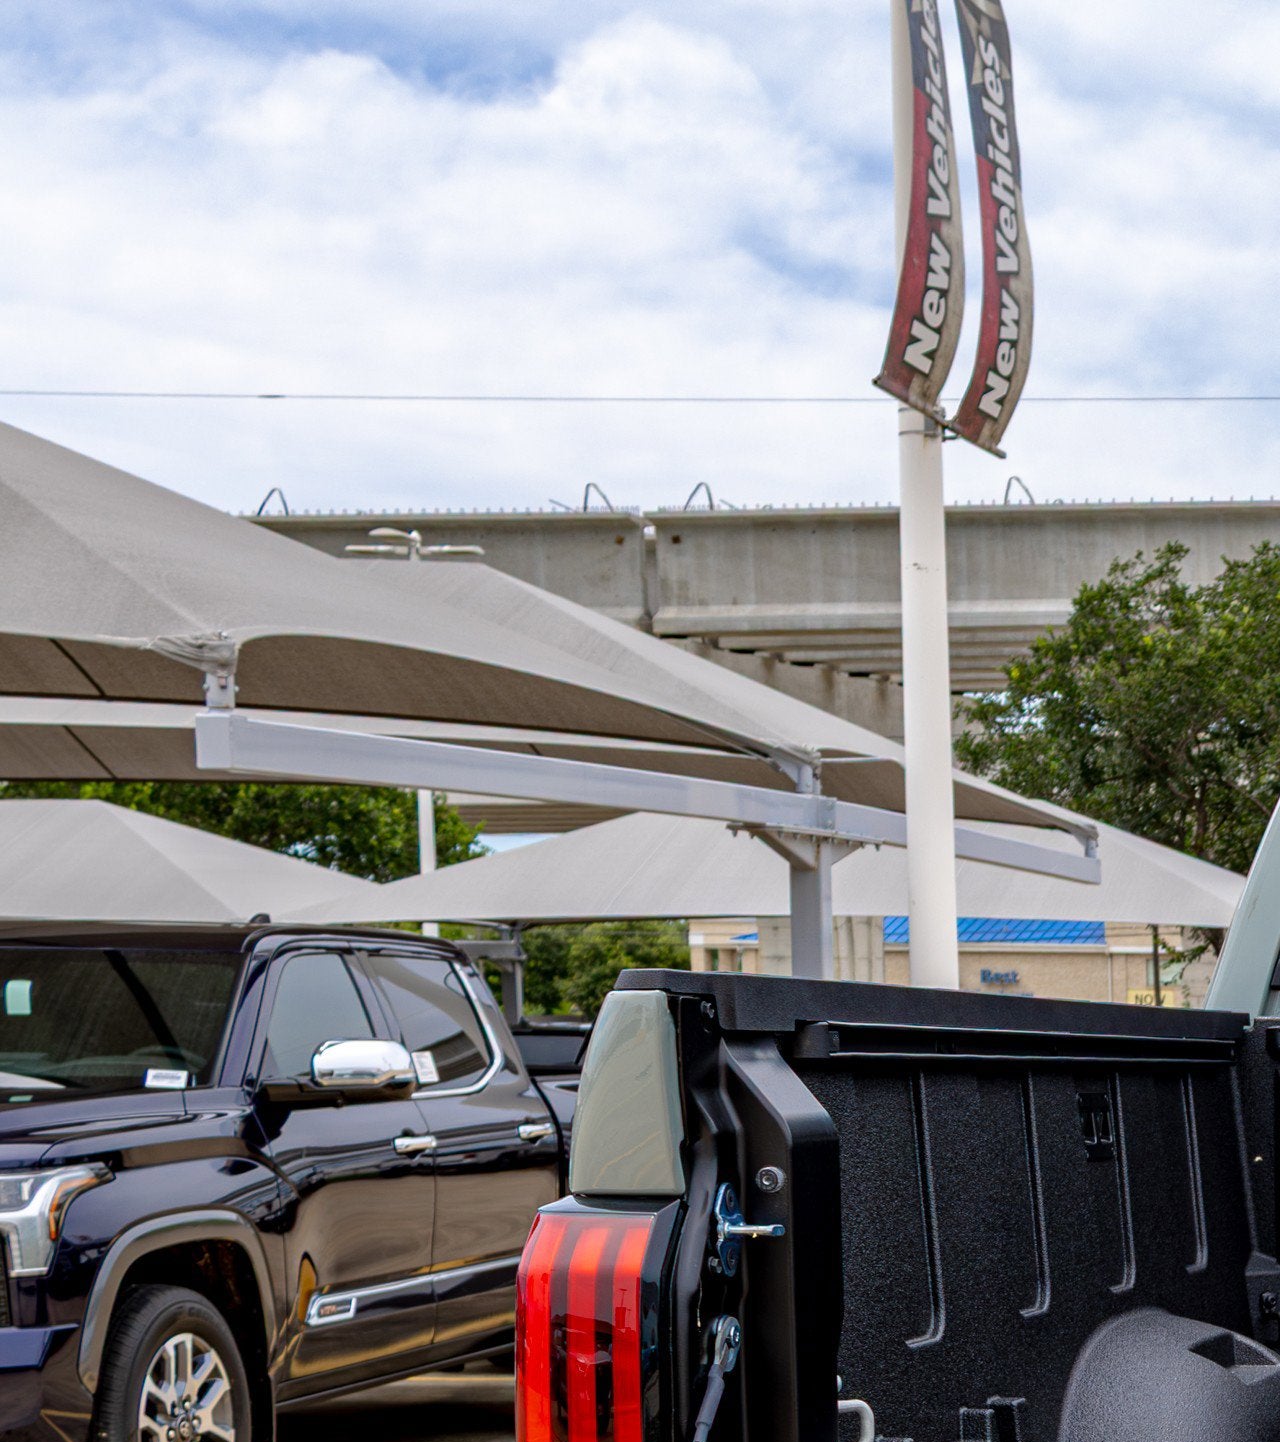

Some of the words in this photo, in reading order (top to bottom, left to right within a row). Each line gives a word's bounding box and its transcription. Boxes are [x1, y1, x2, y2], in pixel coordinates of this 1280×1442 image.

[979, 35, 1020, 273] Vehicles
[903, 232, 951, 375] New
[978, 288, 1020, 419] New
